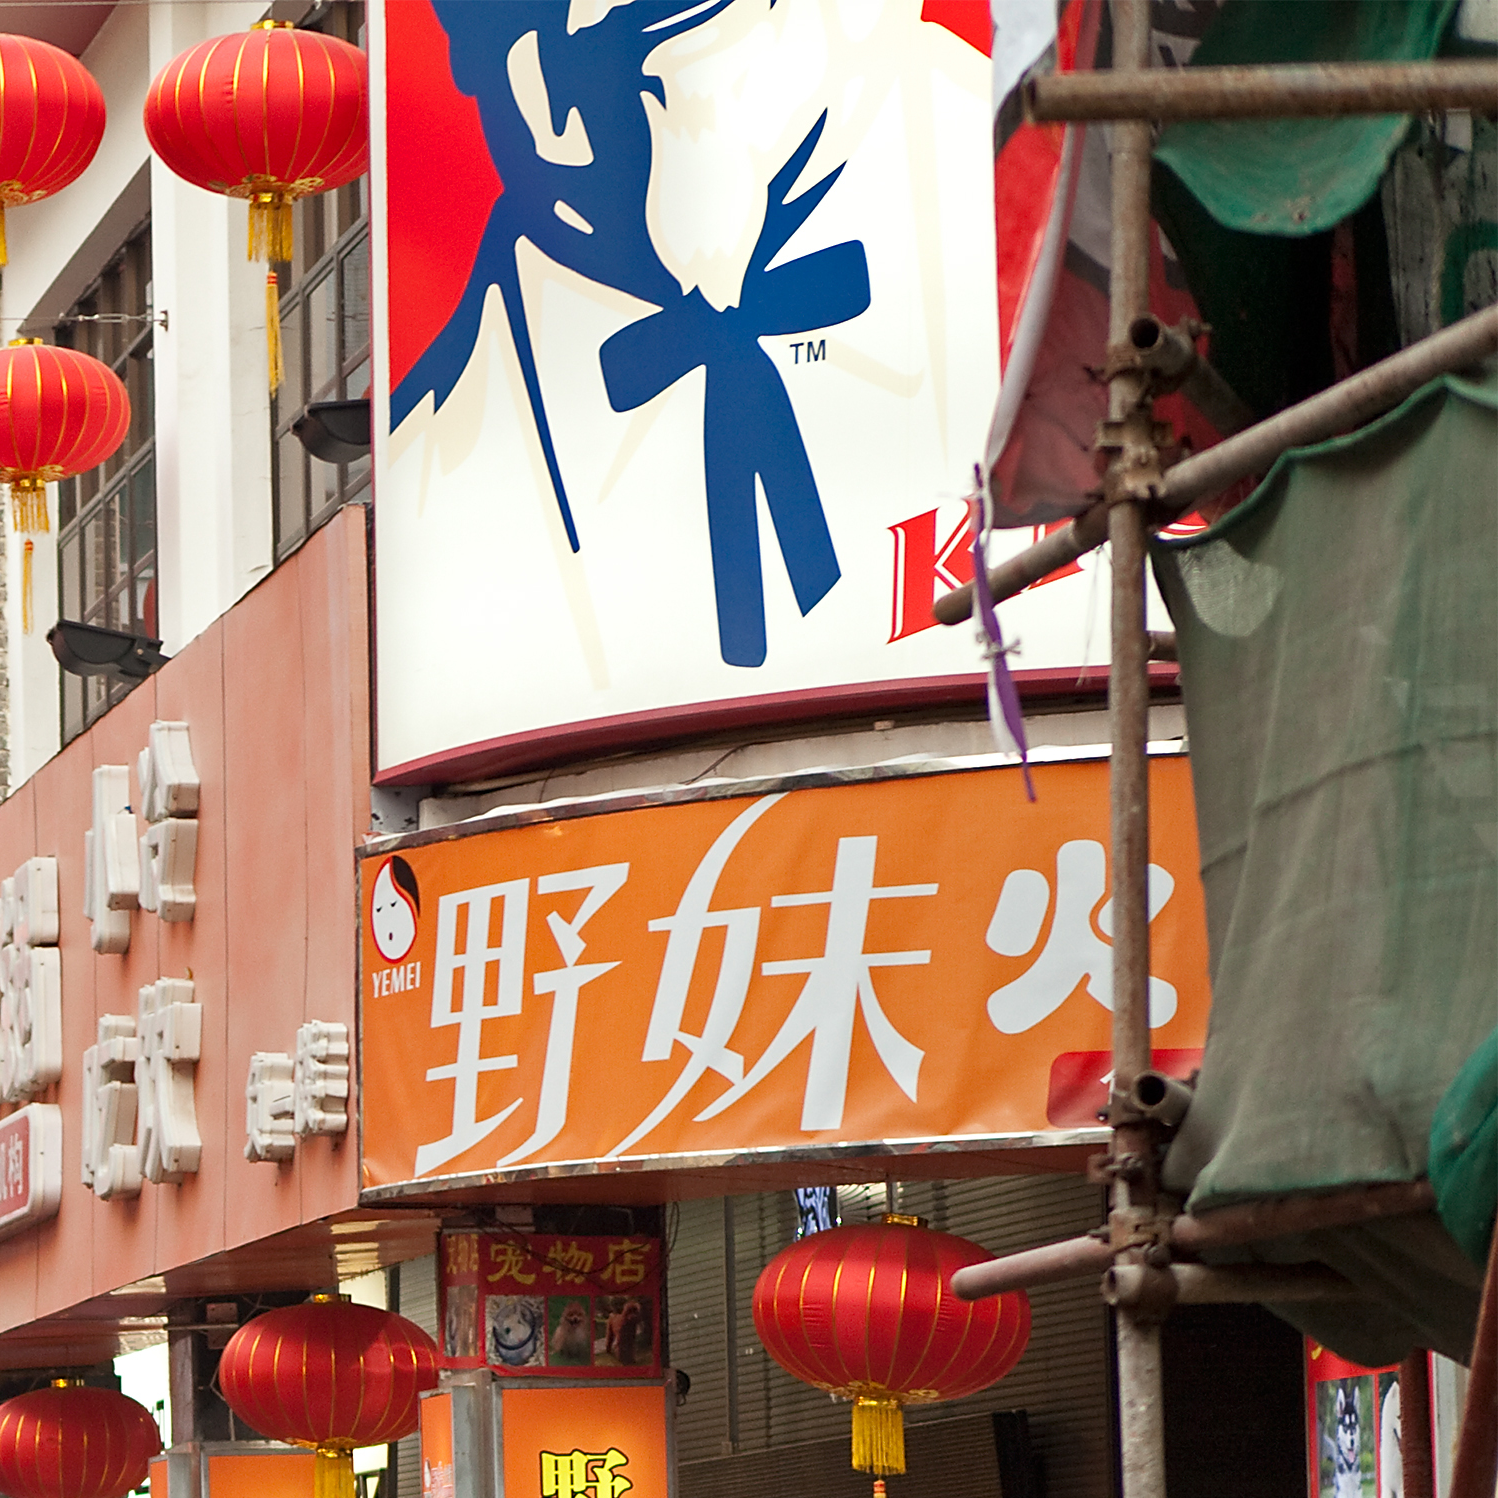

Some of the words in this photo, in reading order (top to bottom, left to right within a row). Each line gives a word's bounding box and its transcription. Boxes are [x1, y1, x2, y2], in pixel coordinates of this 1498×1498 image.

[790, 342, 827, 364] TM
[371, 961, 422, 998] YEMEI
[486, 1239, 652, 1286] 宠物店
